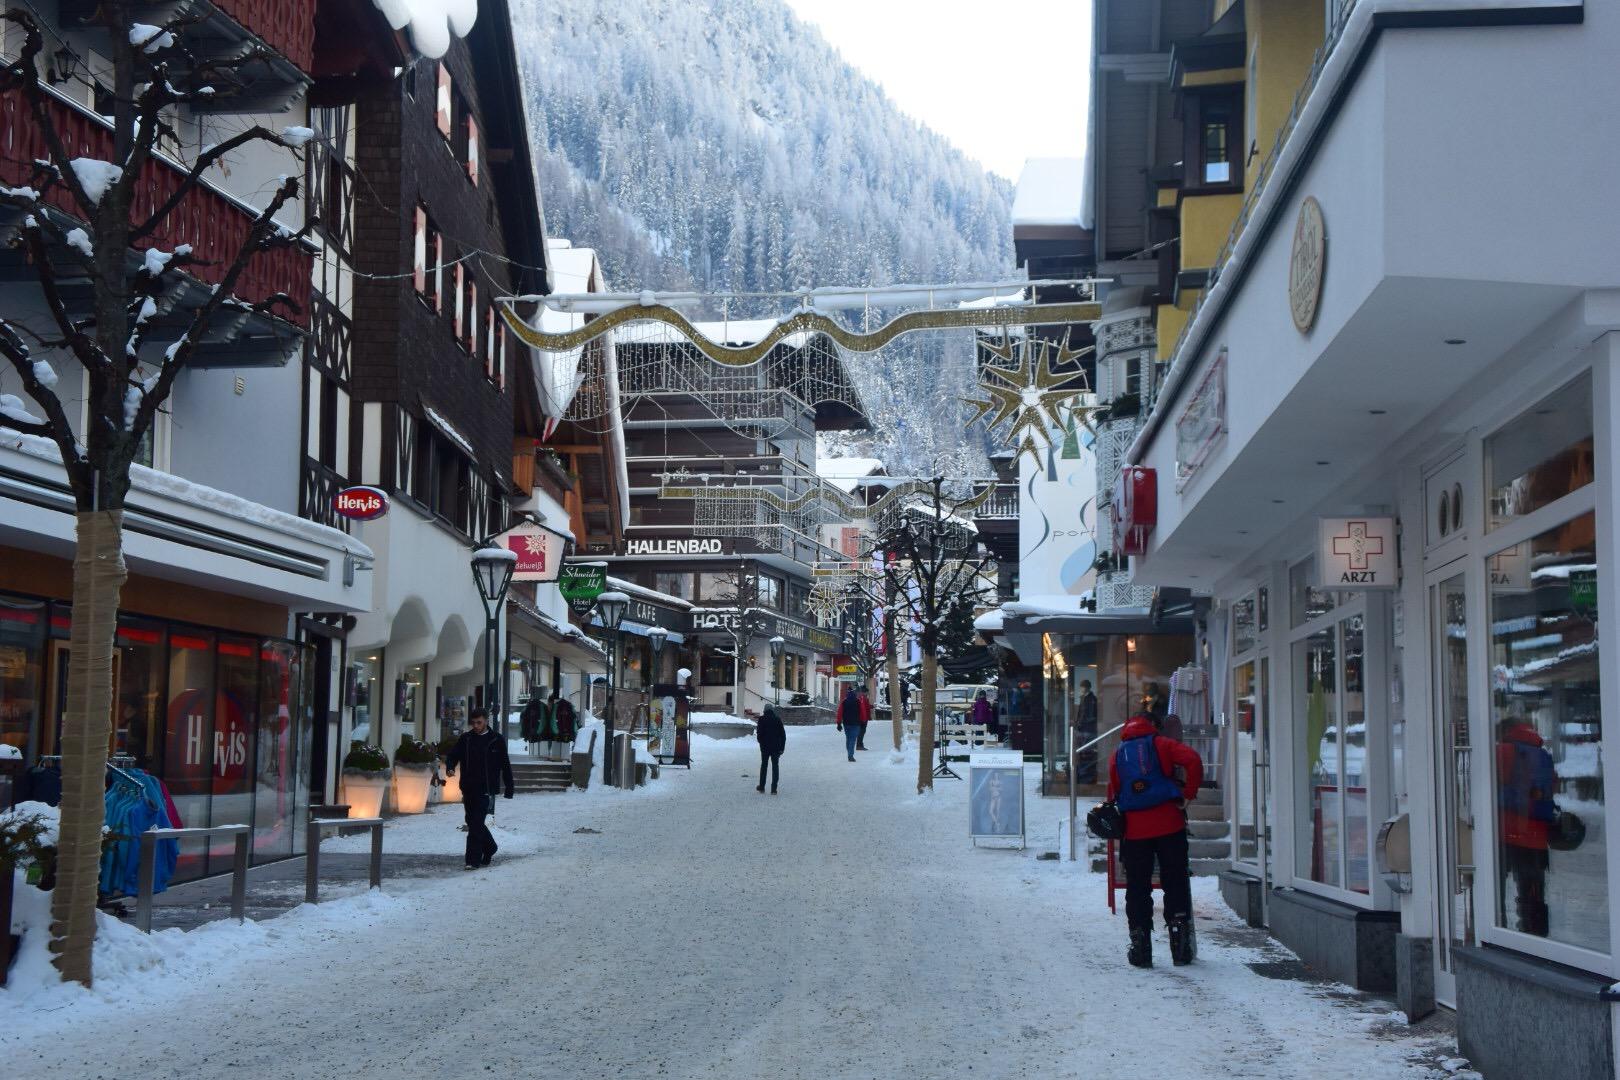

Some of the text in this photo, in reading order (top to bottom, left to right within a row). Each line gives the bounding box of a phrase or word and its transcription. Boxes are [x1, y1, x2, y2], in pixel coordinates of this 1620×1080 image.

[338, 495, 381, 512] Hervis
[627, 539, 722, 554] HALLENBAD
[515, 561, 543, 570] delweiß
[562, 567, 600, 578] Schneider
[1341, 571, 1376, 583] ARZT
[573, 598, 591, 606] Hotel
[693, 614, 753, 628] HOTE
[186, 715, 246, 776] Hrvis
